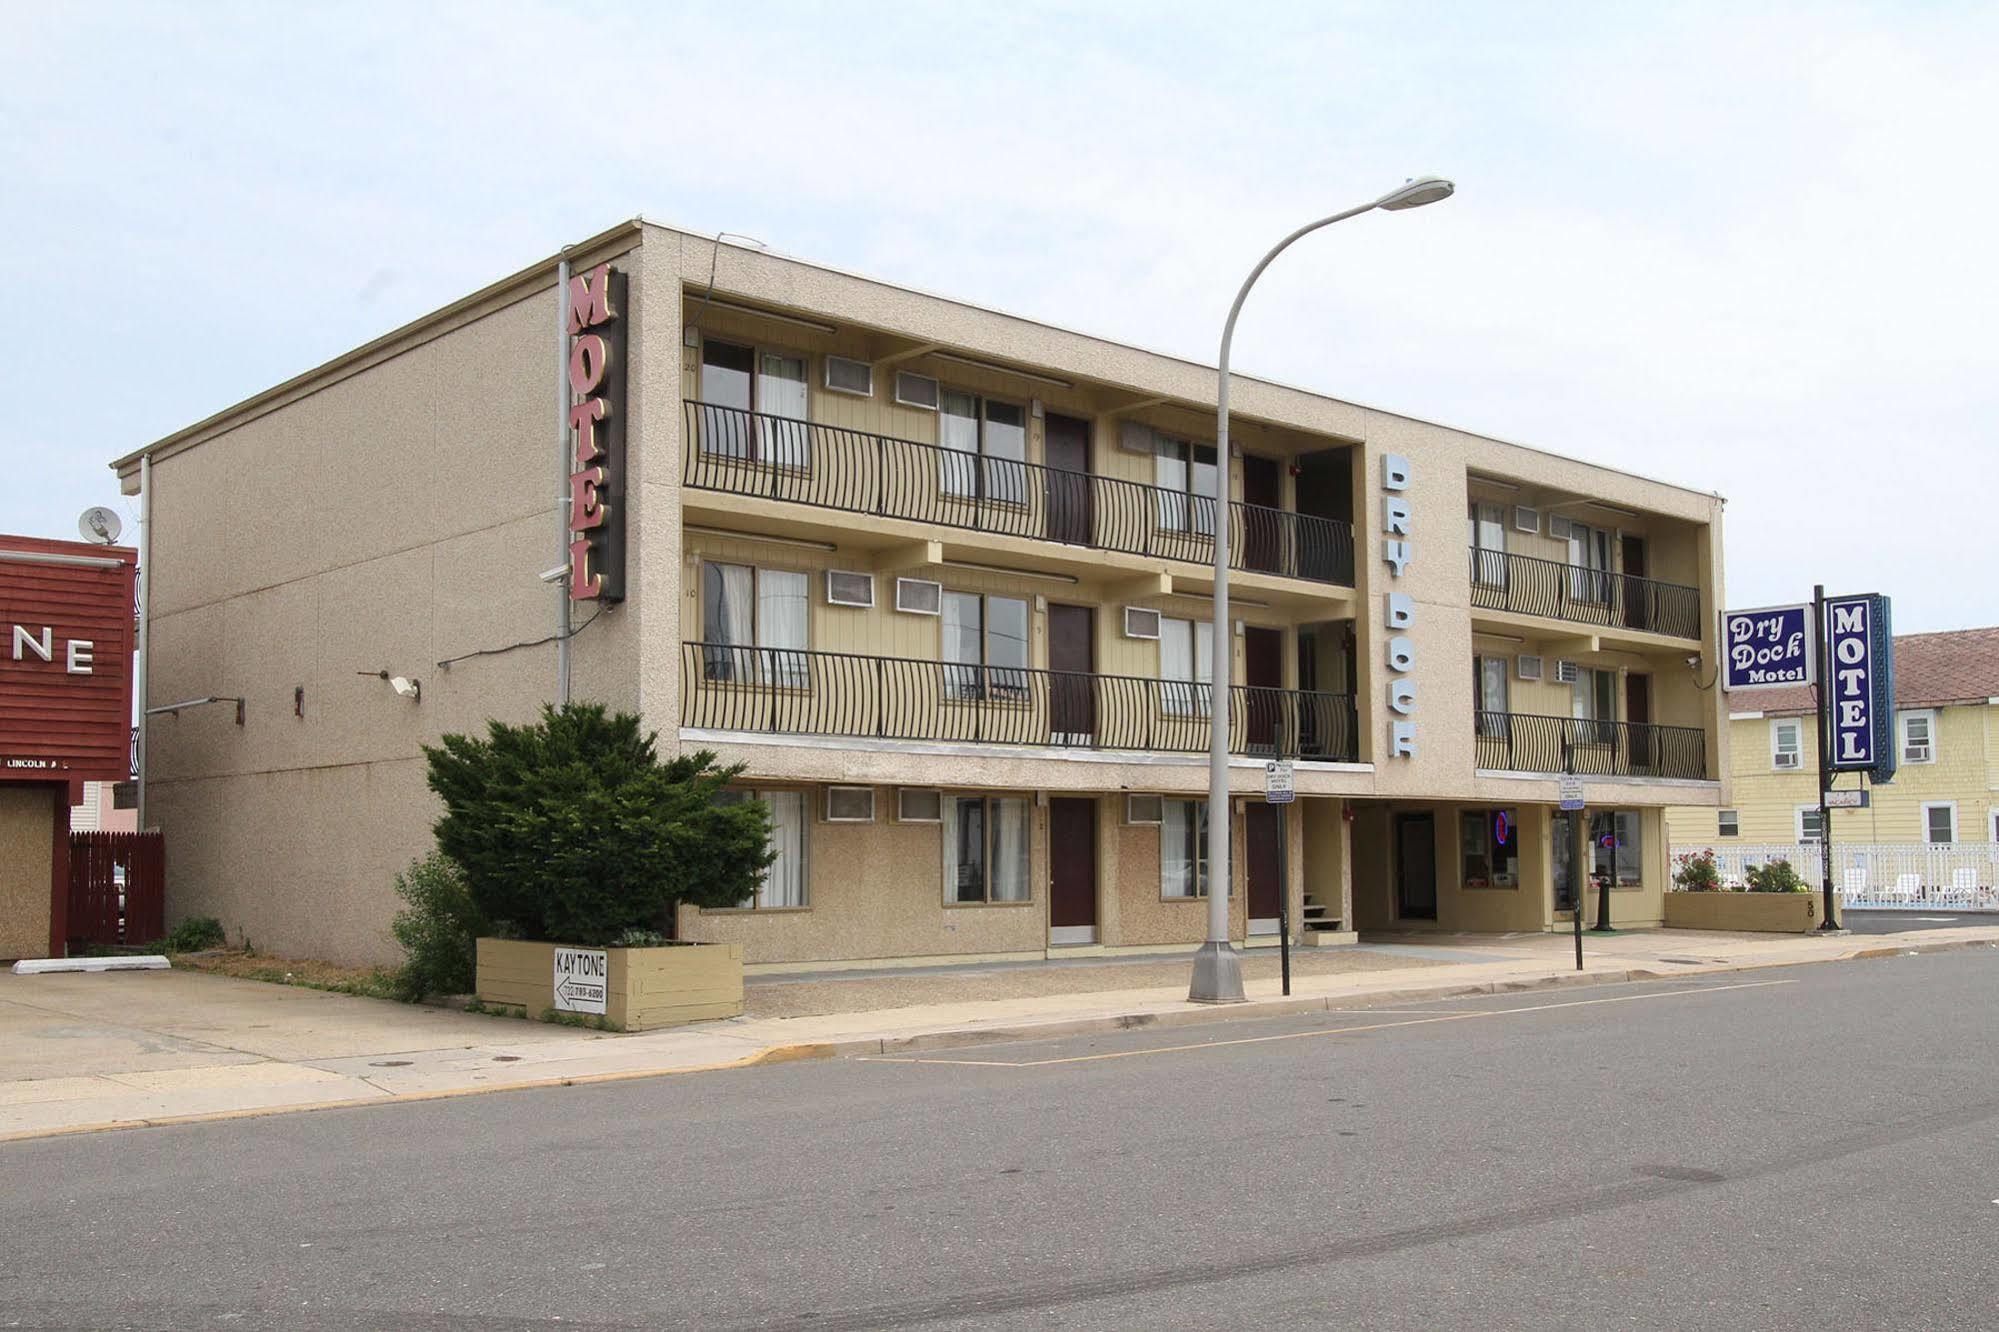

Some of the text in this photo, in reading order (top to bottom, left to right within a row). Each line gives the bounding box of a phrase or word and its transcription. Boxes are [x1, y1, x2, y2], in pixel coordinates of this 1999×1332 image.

[566, 263, 611, 601] MOTEL
[1381, 452, 1413, 578] DRY
[1729, 614, 1785, 645] Dry
[1731, 631, 1804, 672] Dock
[1748, 665, 1805, 684] Motel
[1834, 605, 1866, 760] MOTEL
[7, 759, 47, 768] LINCOLN
[556, 953, 604, 976] KAYTONE
